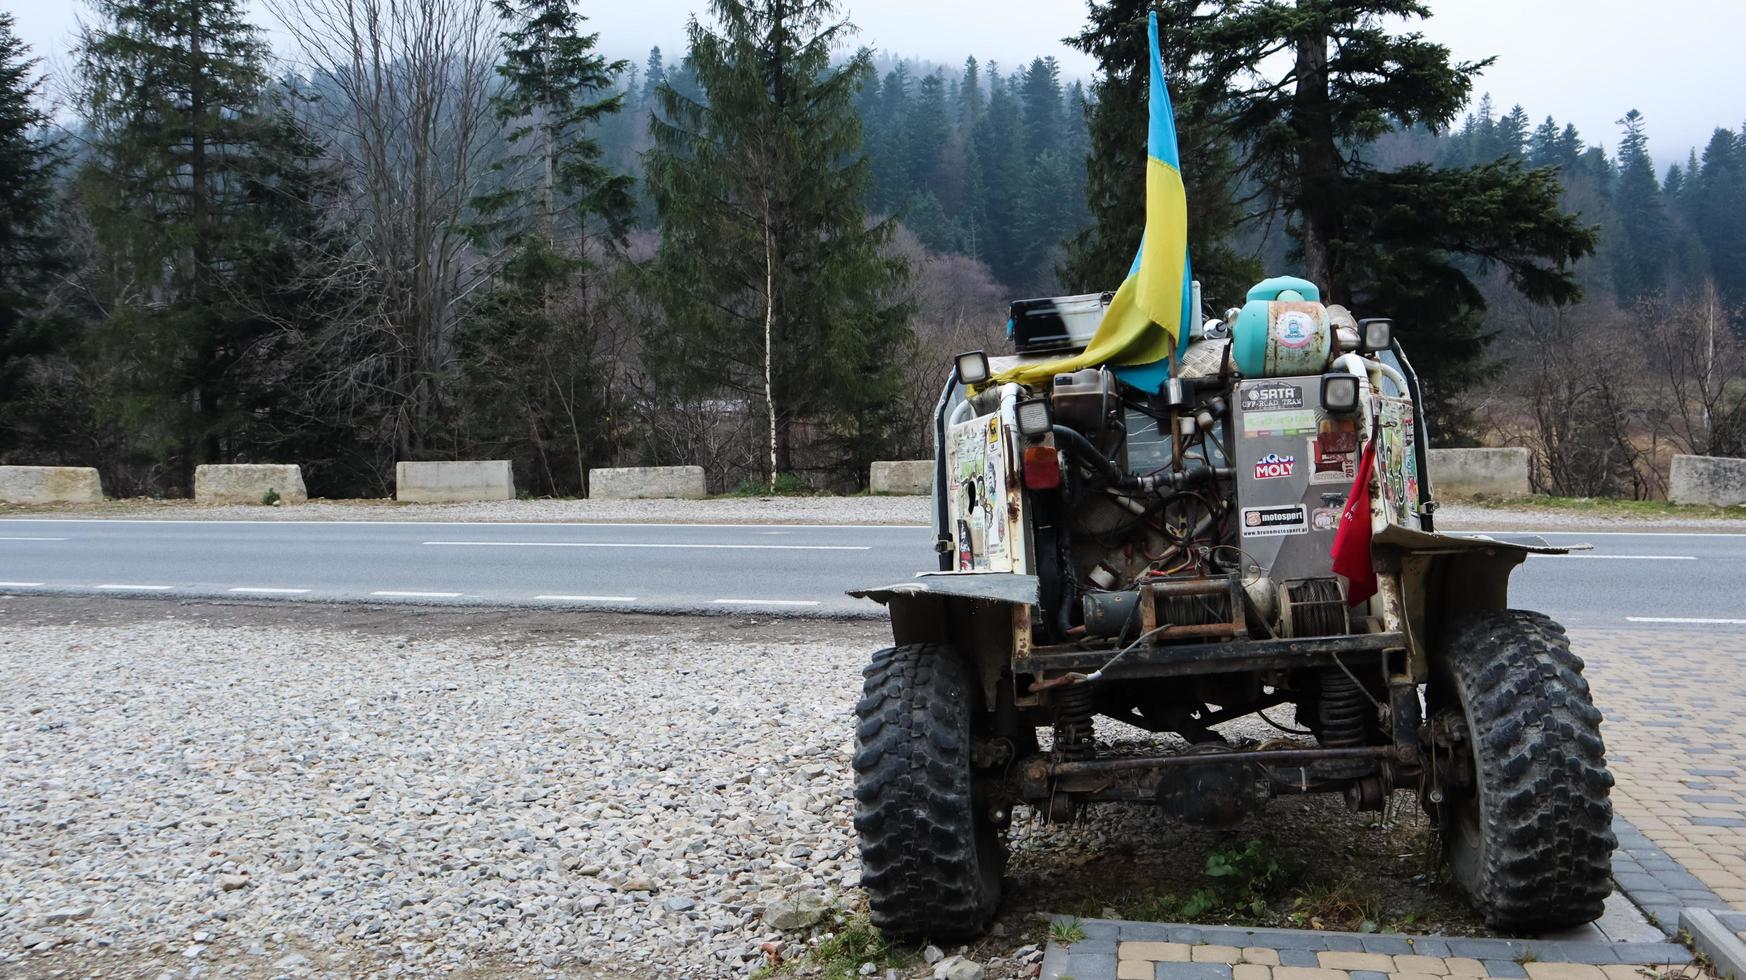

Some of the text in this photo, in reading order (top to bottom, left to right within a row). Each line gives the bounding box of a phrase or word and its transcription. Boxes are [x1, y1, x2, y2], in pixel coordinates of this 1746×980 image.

[1260, 388, 1296, 400] SATA
[1256, 463, 1294, 477] MOLY
[1345, 460, 1354, 478] 2013
[1262, 512, 1303, 522] motosport
